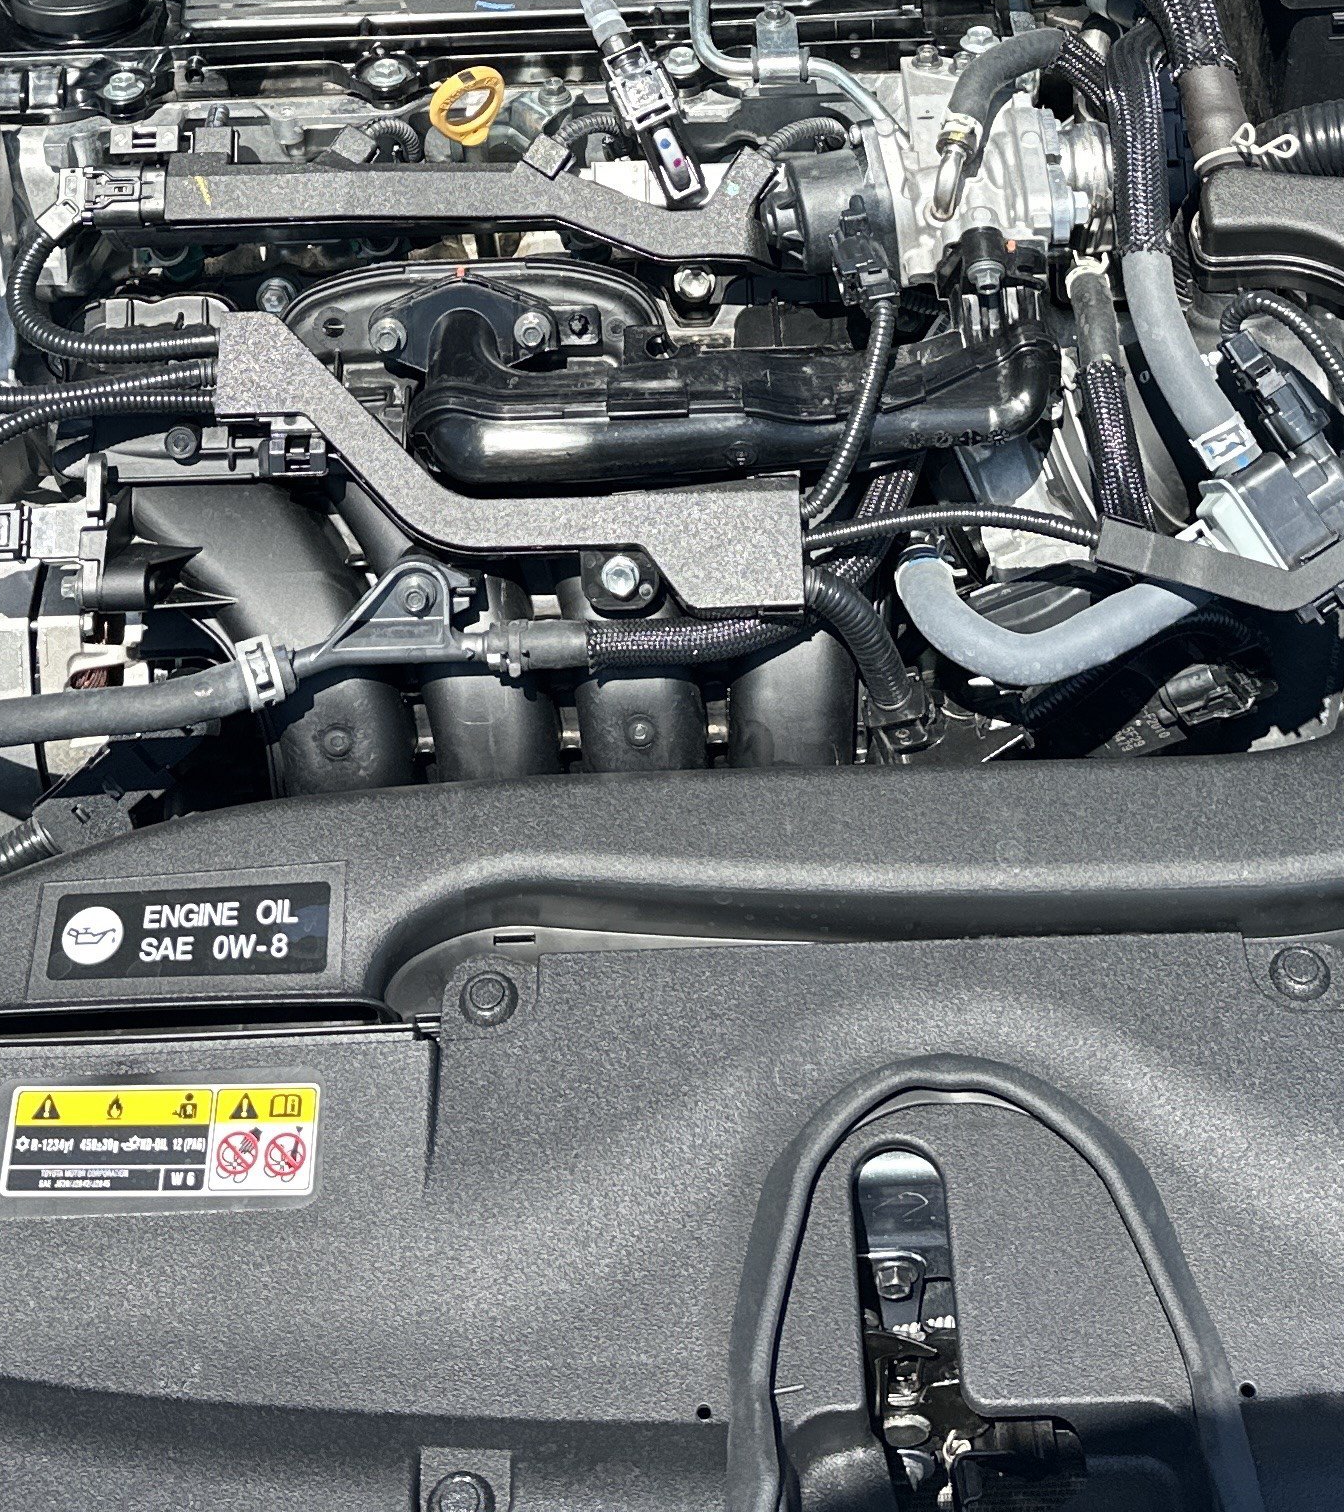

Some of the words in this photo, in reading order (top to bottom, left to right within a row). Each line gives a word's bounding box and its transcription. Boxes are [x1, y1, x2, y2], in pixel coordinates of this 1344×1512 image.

[142, 901, 240, 929] ENGINE
[256, 899, 299, 925] OIL
[139, 936, 195, 962] SAE
[212, 933, 289, 960] 0W-8
[172, 1138, 182, 1151] 12
[40, 1169, 64, 1178] TOYOTA
[64, 1169, 86, 1178] MOTOR
[170, 1172, 184, 1186] W
[38, 1180, 52, 1188] SAE
